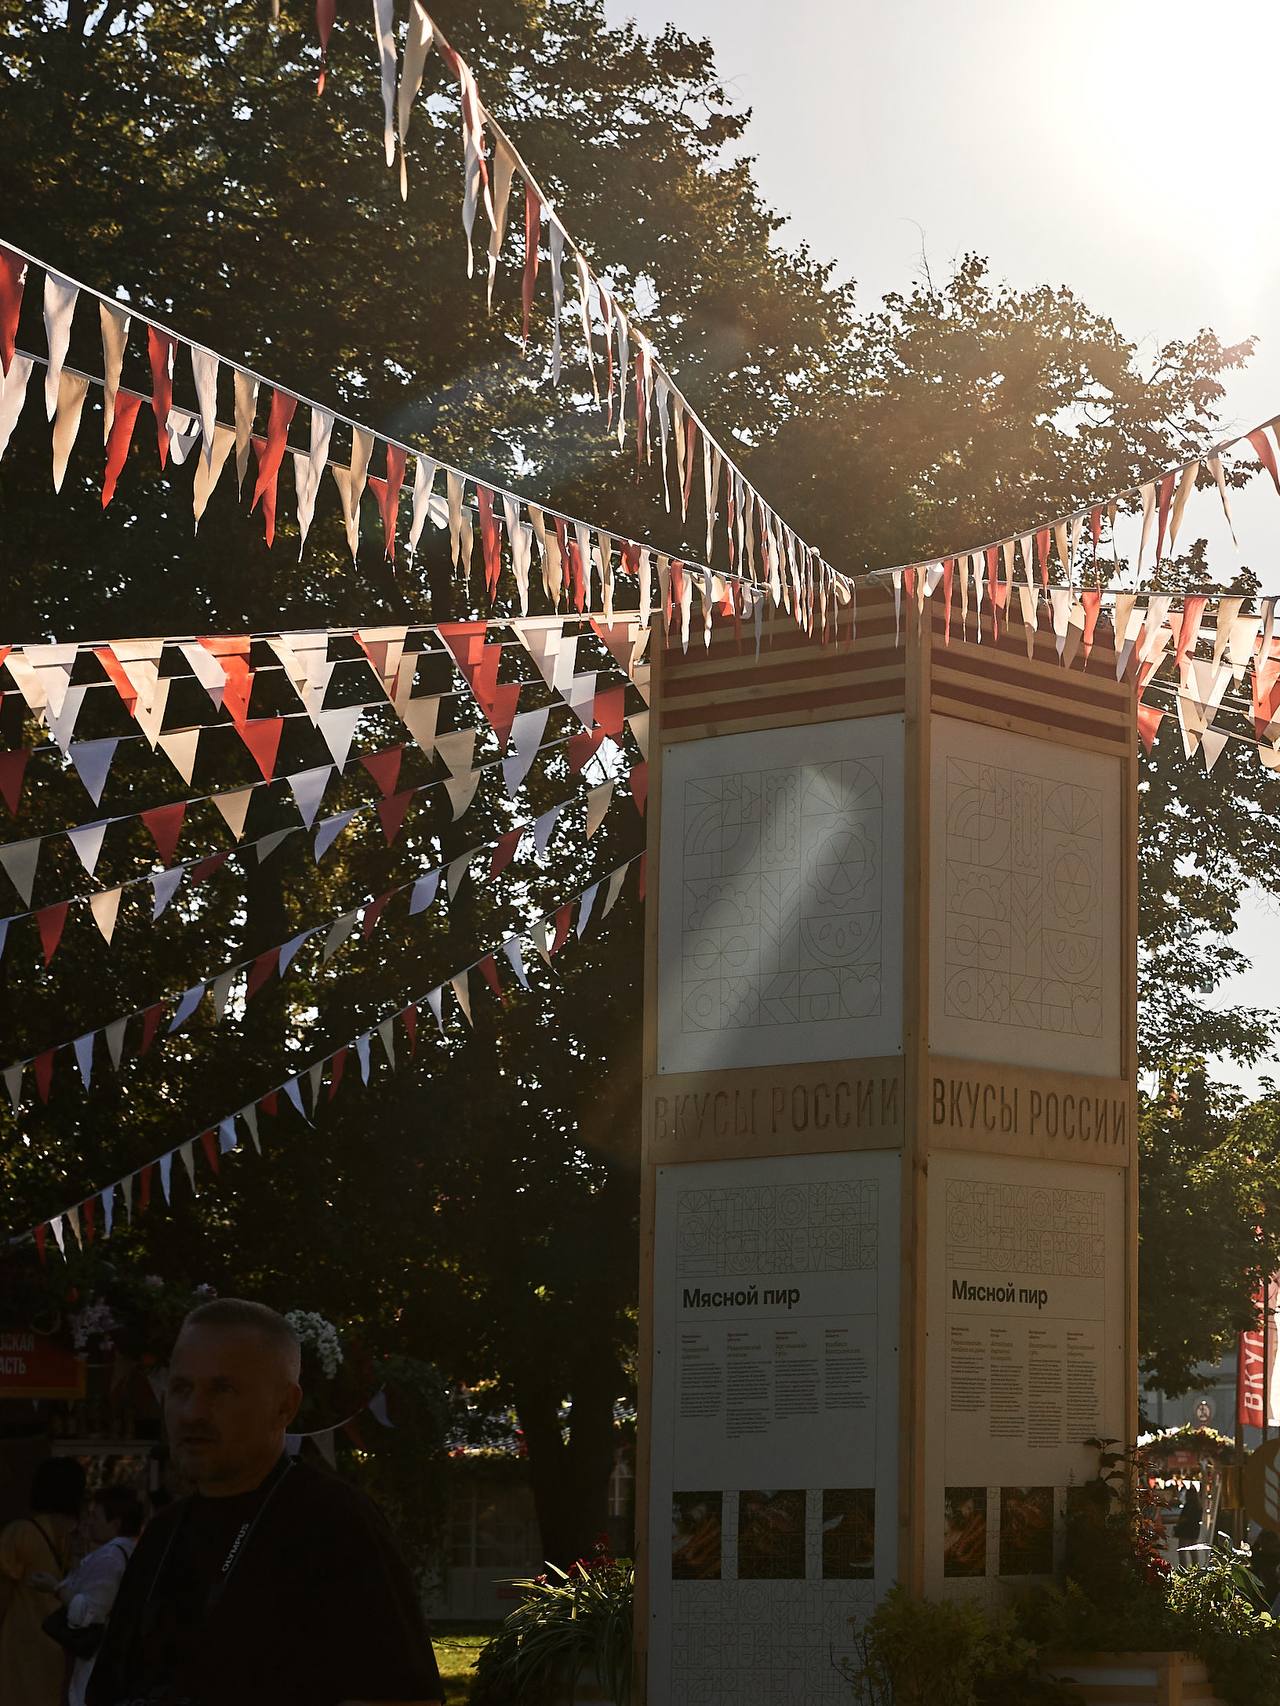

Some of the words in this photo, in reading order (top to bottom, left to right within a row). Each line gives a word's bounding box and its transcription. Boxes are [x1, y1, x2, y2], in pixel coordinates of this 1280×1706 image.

[654, 1088, 758, 1142] ВКУСЫ
[770, 1077, 898, 1134] РОССИИ
[932, 1077, 1018, 1134] ВКУСЫ
[1029, 1089, 1126, 1145] РОССИИ
[683, 1284, 758, 1308] Мясной
[763, 1287, 800, 1310] пир
[952, 1279, 1016, 1303] Мясной
[1019, 1288, 1049, 1310] пир
[221, 1521, 250, 1572] OLYMPUS
